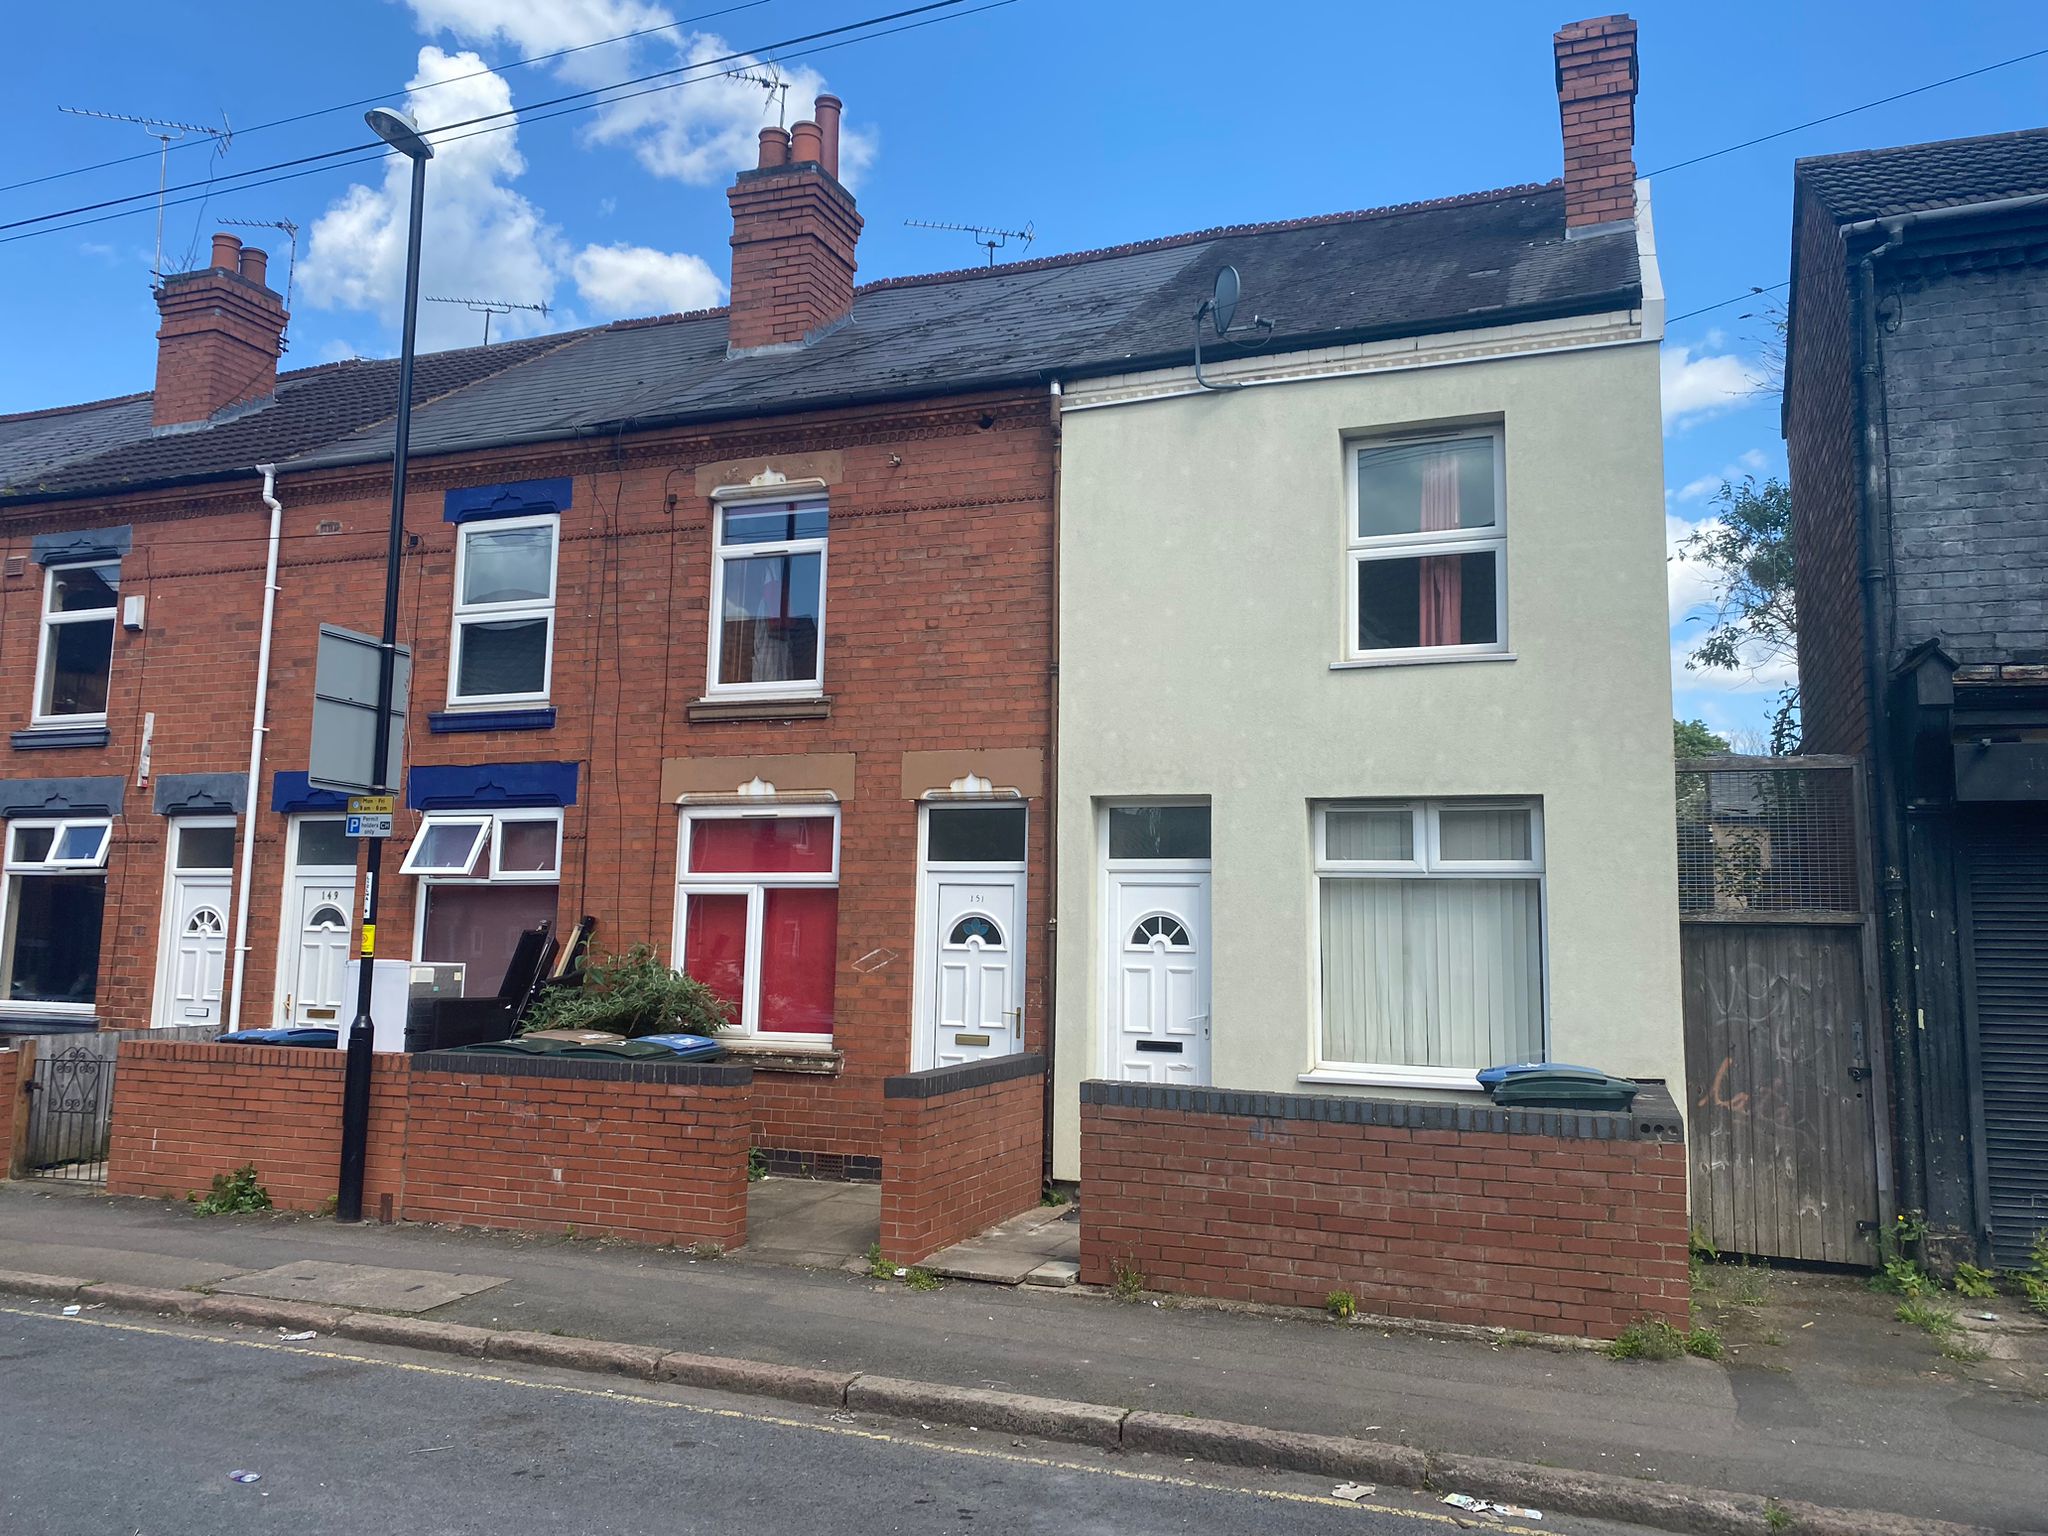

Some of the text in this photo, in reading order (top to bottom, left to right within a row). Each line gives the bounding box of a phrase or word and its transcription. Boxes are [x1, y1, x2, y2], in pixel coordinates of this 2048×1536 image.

[350, 819, 359, 832] P
[321, 891, 339, 900] 149
[970, 894, 984, 903] 151
